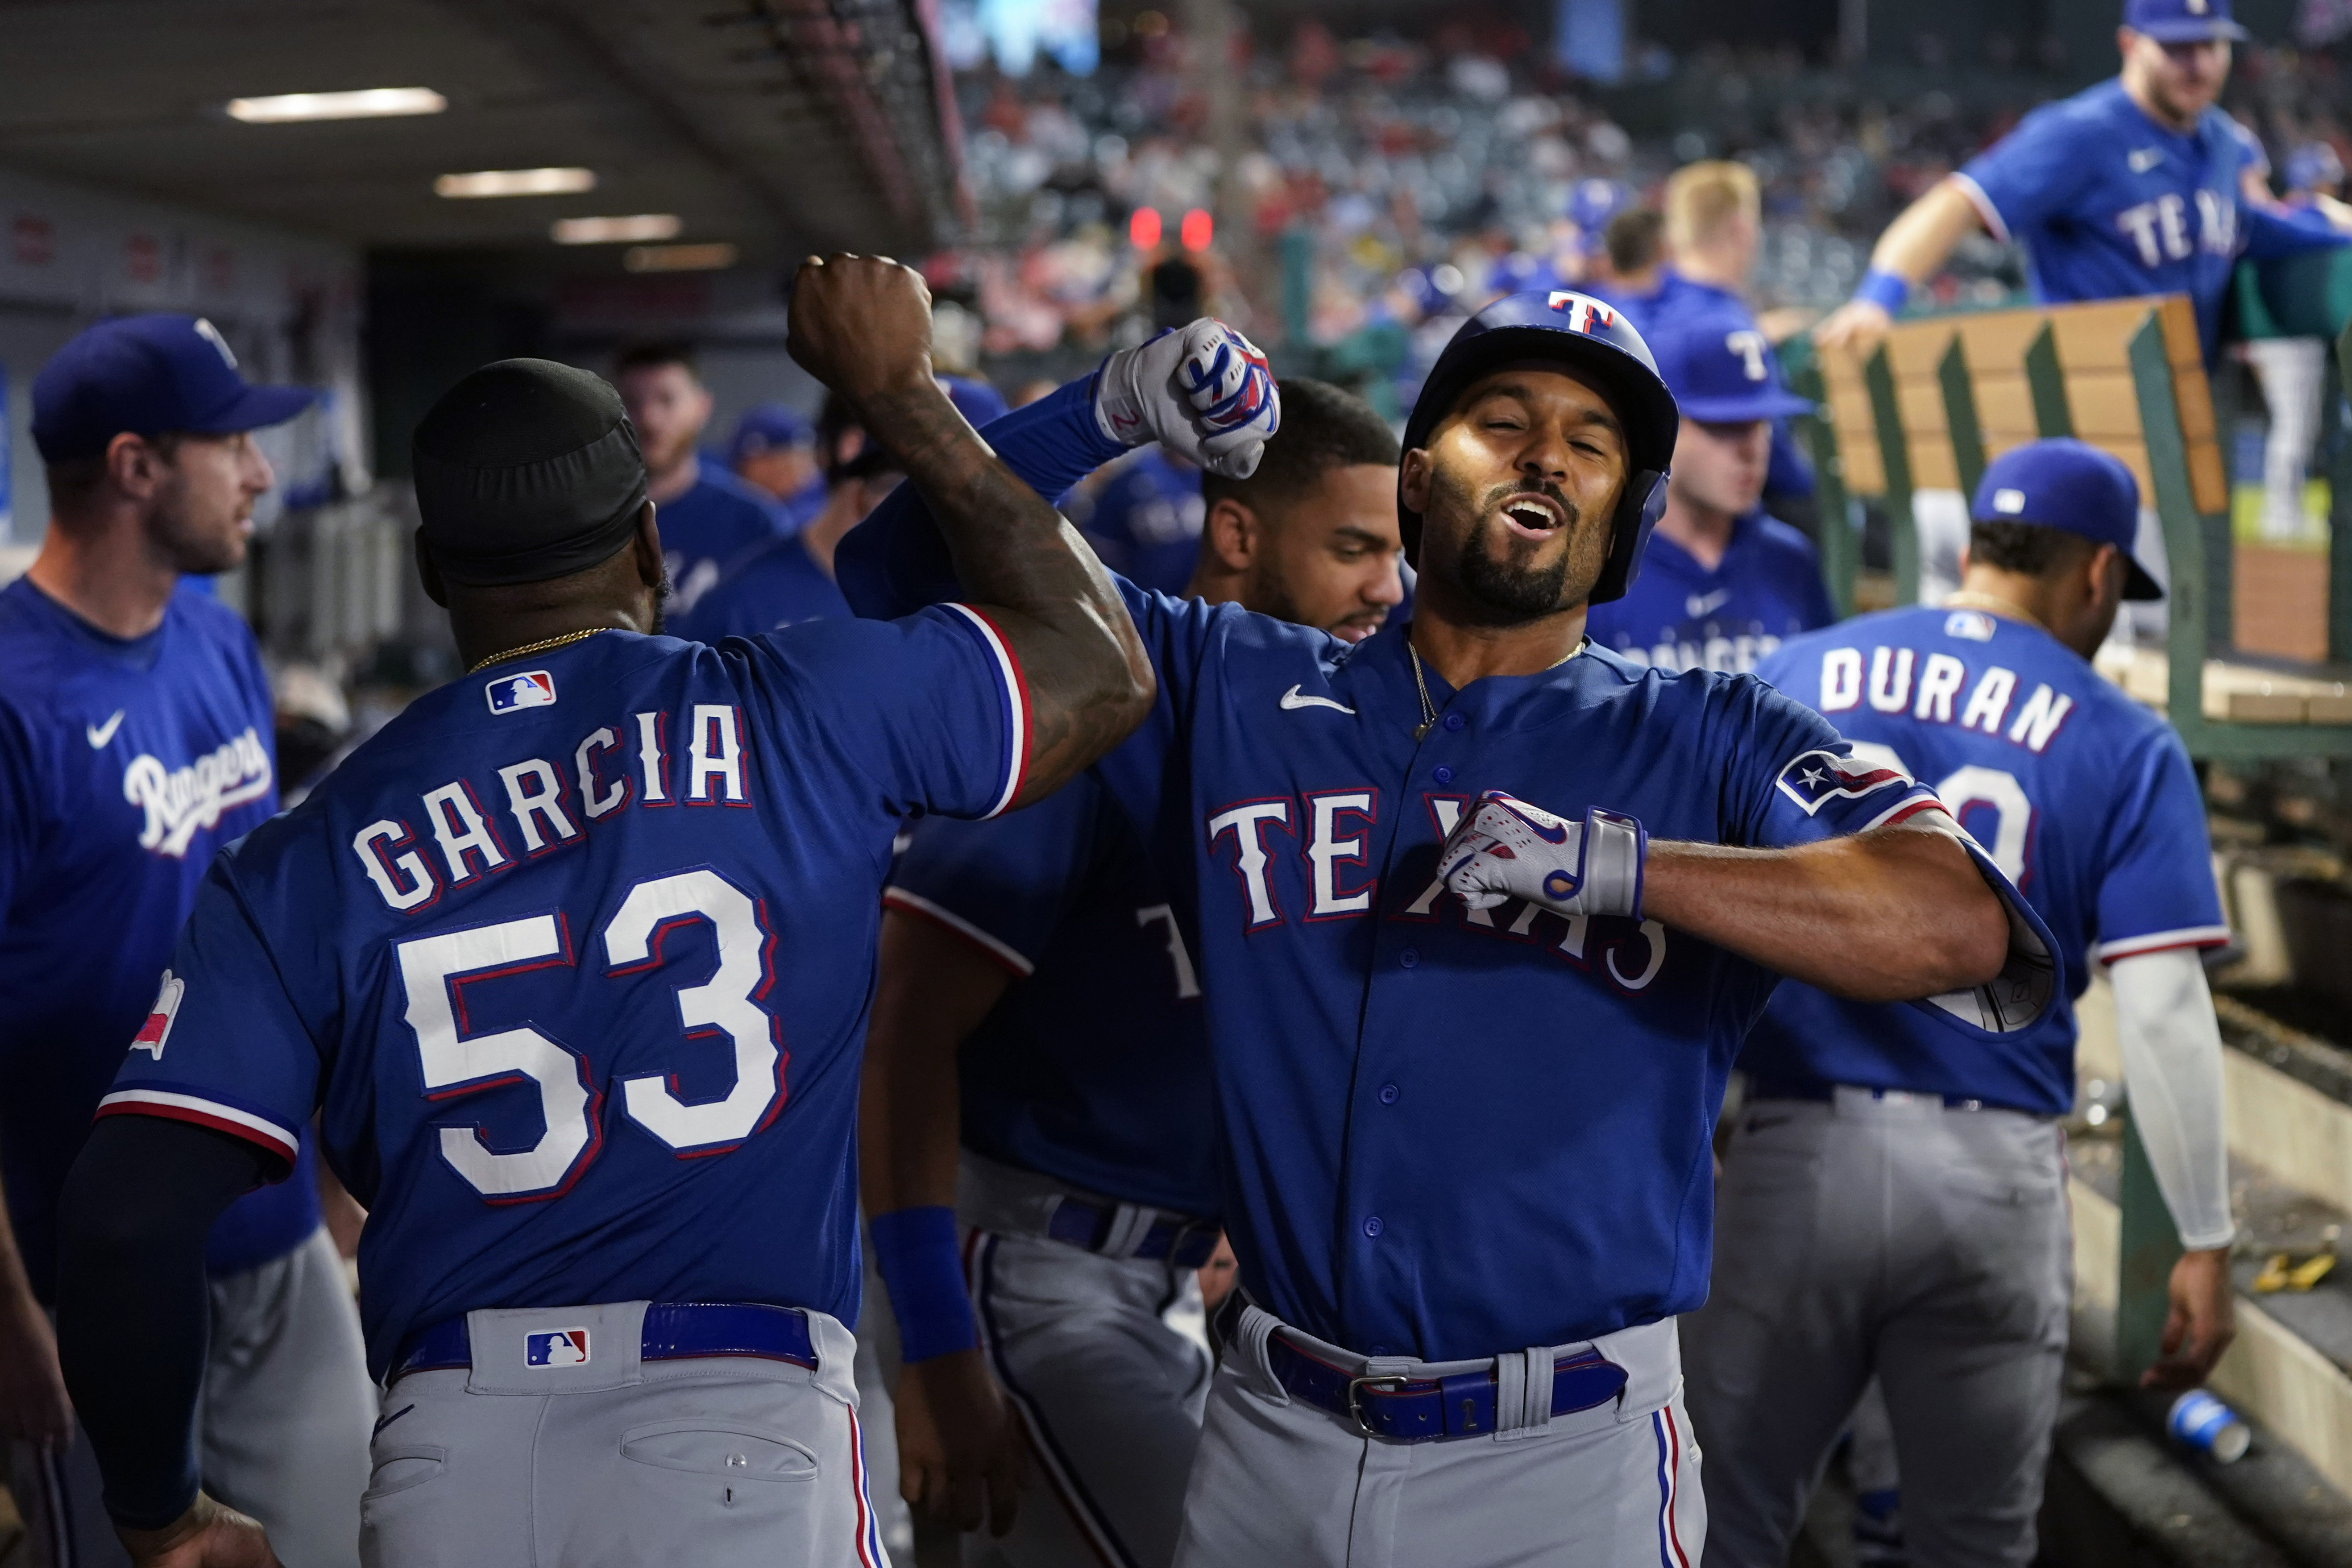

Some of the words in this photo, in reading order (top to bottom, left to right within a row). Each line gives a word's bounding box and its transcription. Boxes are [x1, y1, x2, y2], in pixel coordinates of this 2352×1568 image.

[1548, 291, 1612, 334] T
[1725, 329, 1768, 381] T
[1819, 646, 2077, 756] DURAN
[122, 726, 272, 858] Rangers
[352, 703, 752, 915] GARCIA
[1843, 740, 2037, 895] 0
[390, 863, 790, 1206] 53
